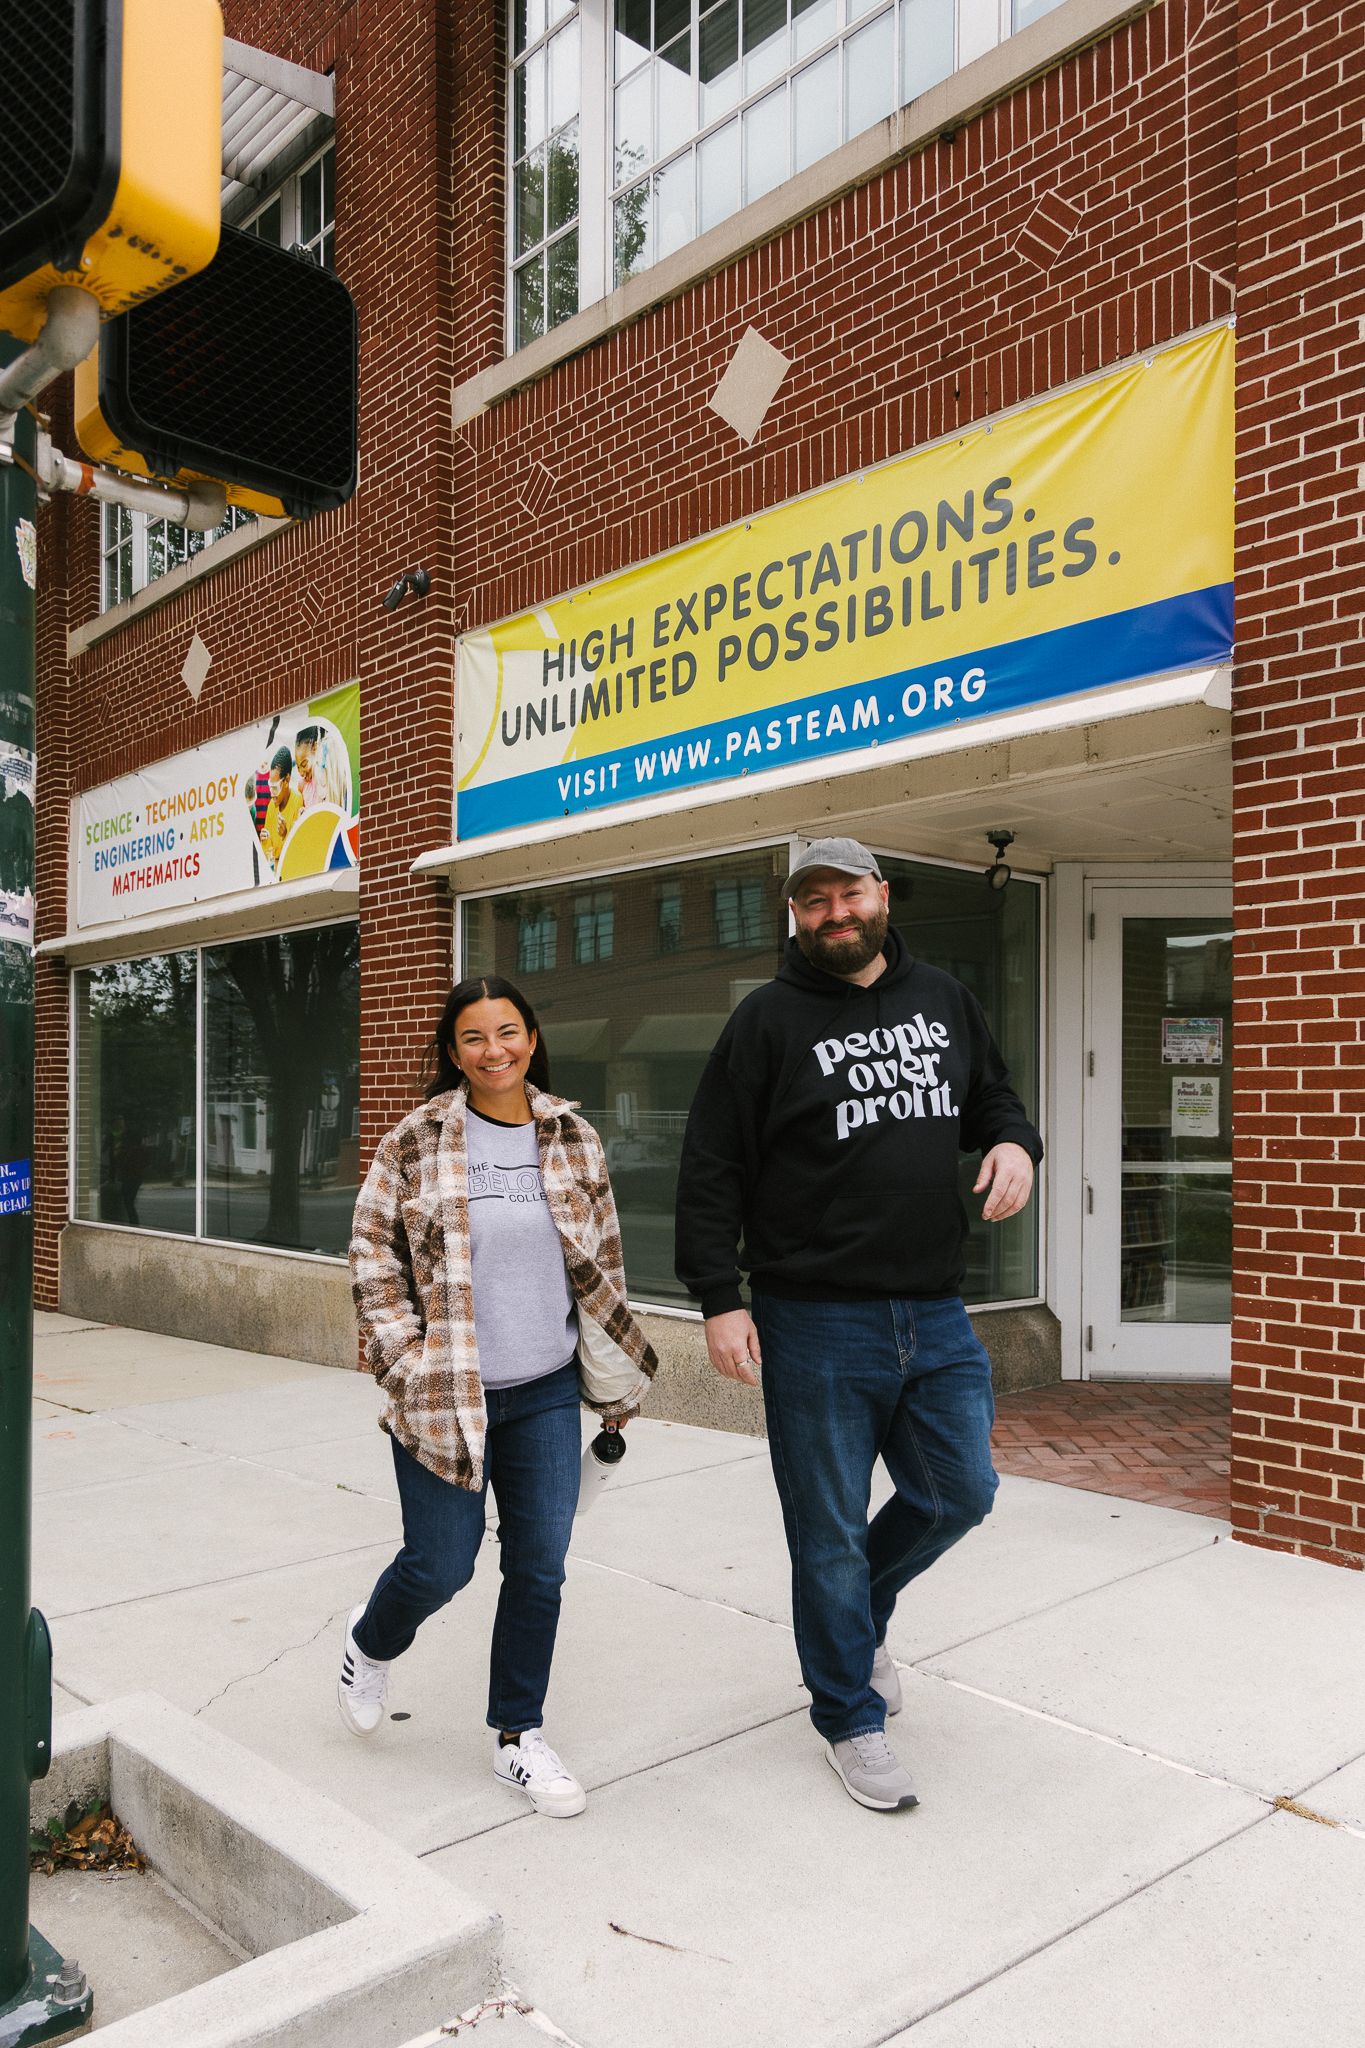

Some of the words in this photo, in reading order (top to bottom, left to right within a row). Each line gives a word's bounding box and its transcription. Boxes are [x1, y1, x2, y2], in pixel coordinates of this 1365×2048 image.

[543, 616, 635, 687] HIGH
[653, 476, 1036, 649] EXPECTATIONS.
[501, 651, 697, 747] UNLIMITED
[718, 516, 1121, 682] POSSIBILITIES.
[557, 762, 621, 801] VISIT
[634, 667, 987, 783] WWW.PASTEAM.ORG
[86, 811, 132, 846] SCIENCE
[145, 773, 239, 826] TECHNOLOGY
[94, 827, 175, 872] ENGINEERING
[189, 812, 225, 844] ARTS
[112, 852, 200, 896] MATHEMATICS
[812, 1012, 950, 1077] people
[847, 1053, 941, 1092] over
[835, 1080, 960, 1141] profit.
[468, 1161, 490, 1176] THE
